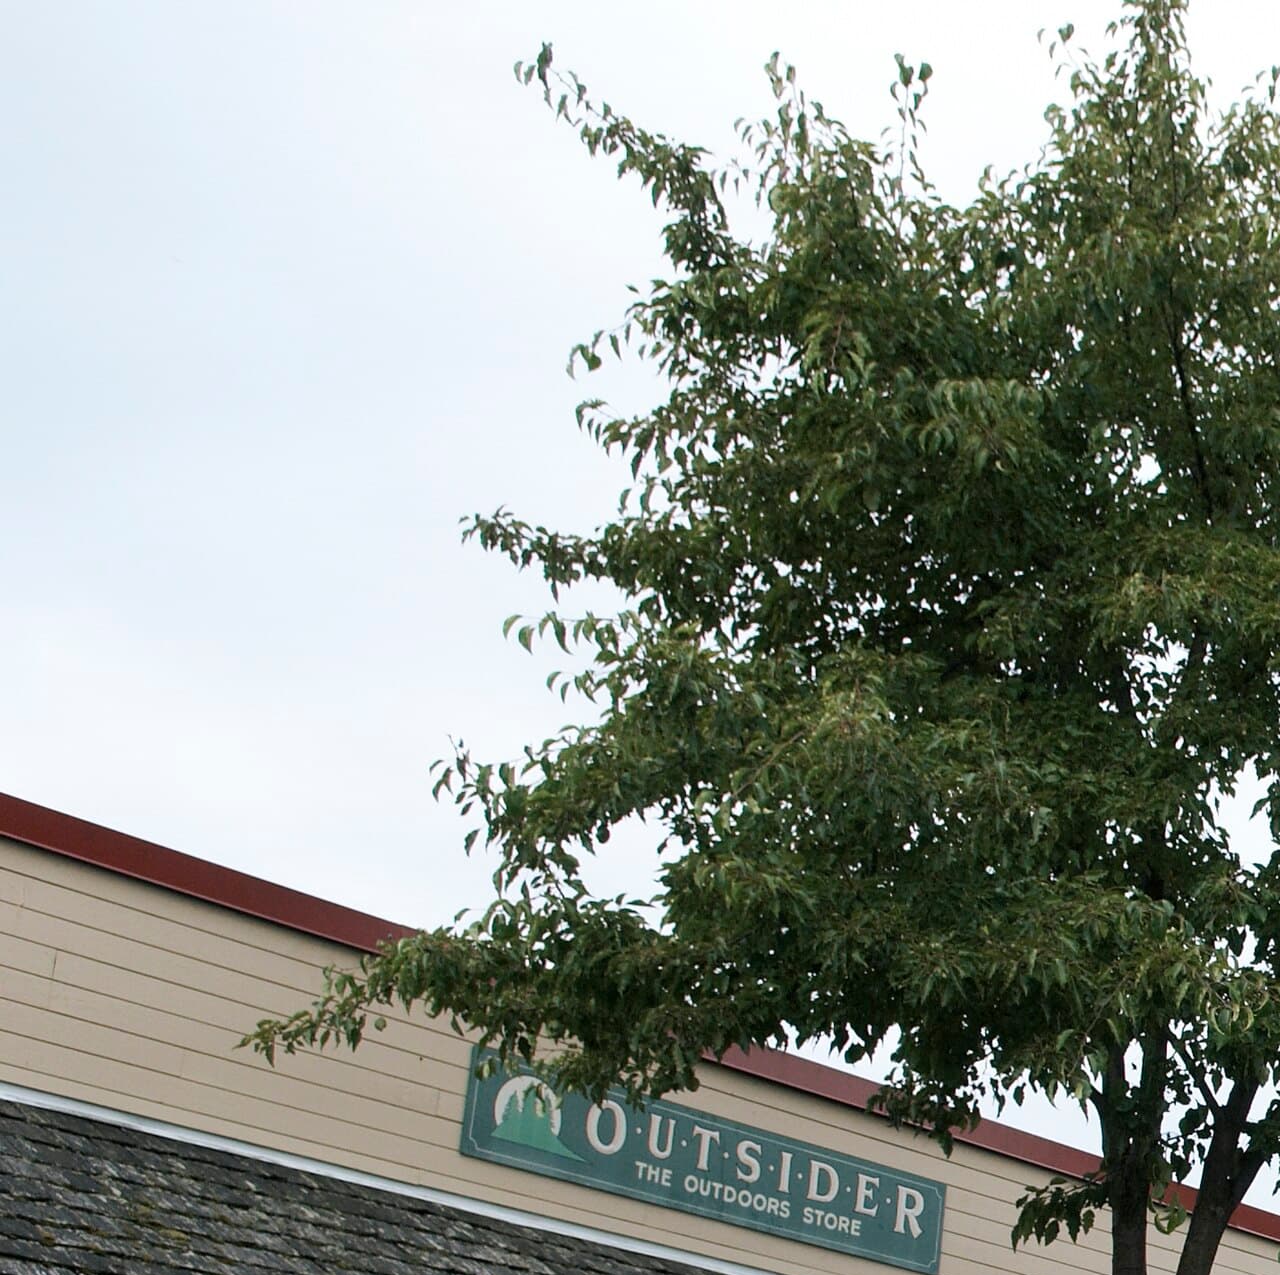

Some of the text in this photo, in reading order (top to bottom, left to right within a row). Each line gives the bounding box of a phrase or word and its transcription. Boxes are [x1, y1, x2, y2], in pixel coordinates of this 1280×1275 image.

[635, 1161, 862, 1237] THE OUTDOORS STORE
